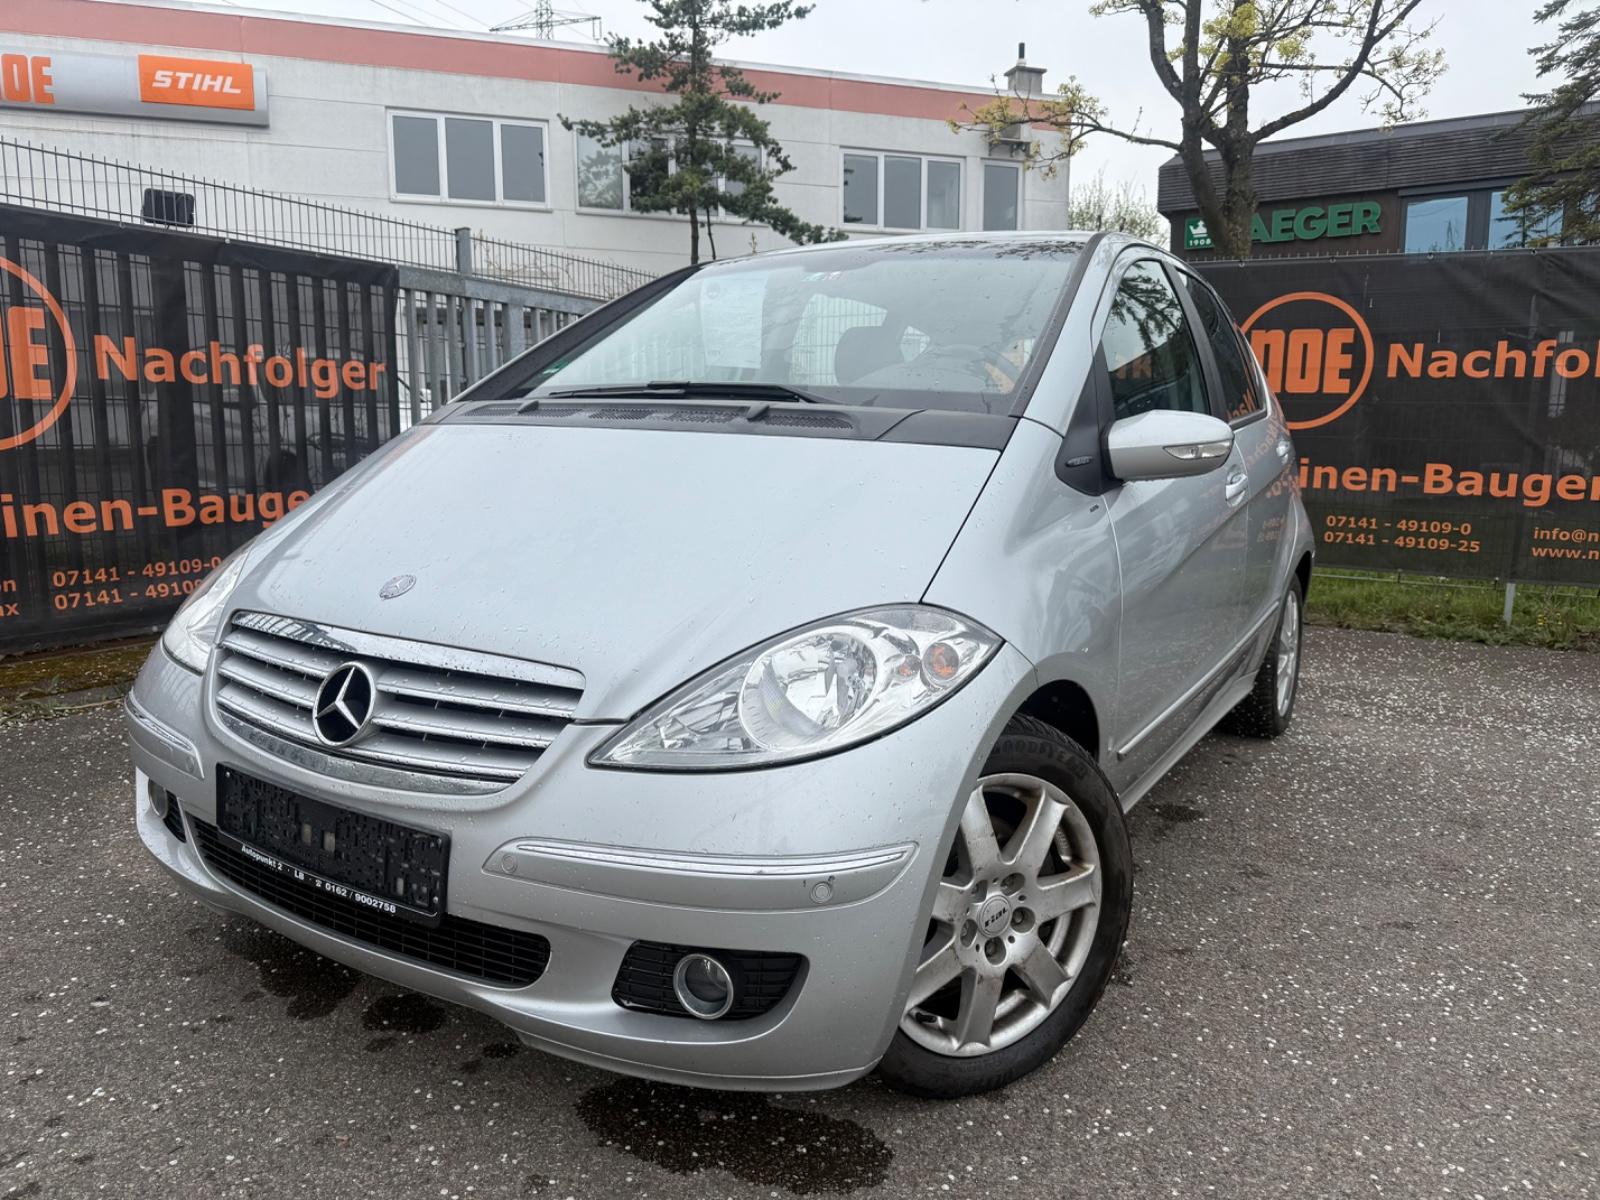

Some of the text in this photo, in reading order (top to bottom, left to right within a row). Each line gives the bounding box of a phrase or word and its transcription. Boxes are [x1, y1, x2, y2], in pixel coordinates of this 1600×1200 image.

[152, 70, 242, 94] STIHL
[93, 334, 387, 399] Nachfolger
[1326, 515, 1378, 529] 07141
[1396, 519, 1472, 536] 49109-0
[1324, 531, 1375, 545] 07141
[1394, 536, 1481, 553] 49109-25
[53, 566, 120, 588] 07141
[54, 588, 123, 610] 07141
[325, 882, 347, 897] 0162
